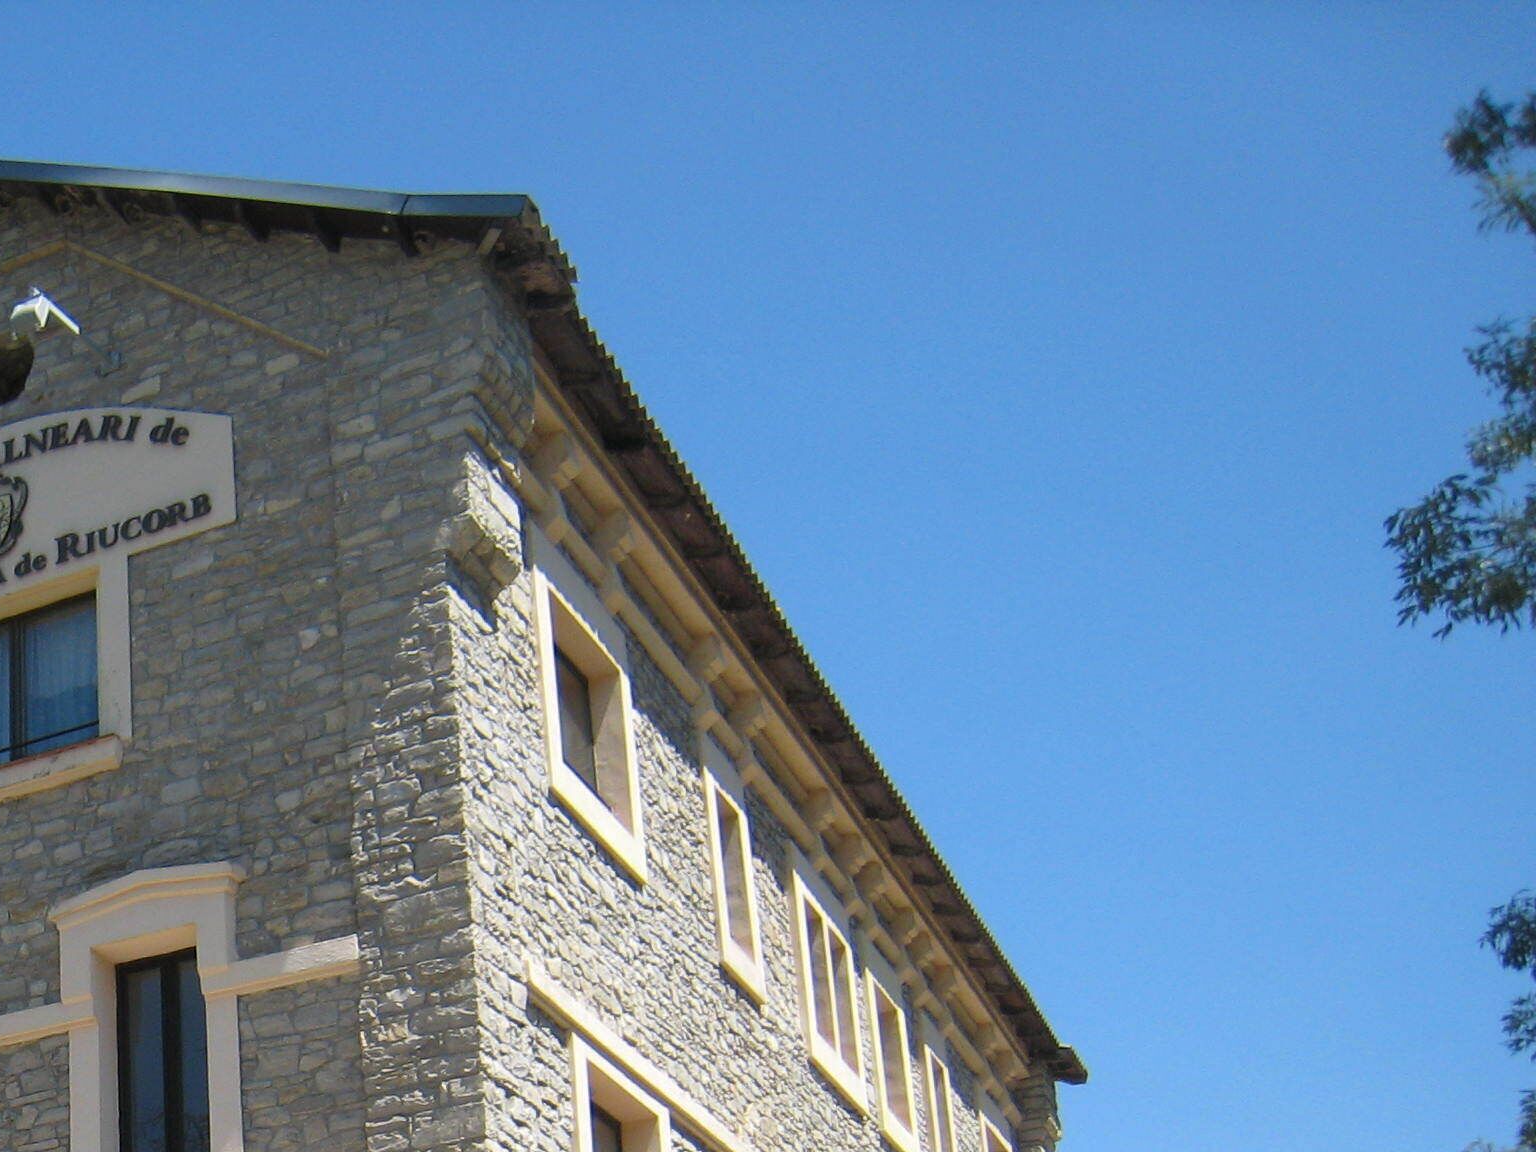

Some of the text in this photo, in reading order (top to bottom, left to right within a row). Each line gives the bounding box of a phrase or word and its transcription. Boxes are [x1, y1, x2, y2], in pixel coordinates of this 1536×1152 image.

[149, 417, 190, 447] de
[14, 552, 47, 579] de
[54, 494, 213, 564] RIUCORB
